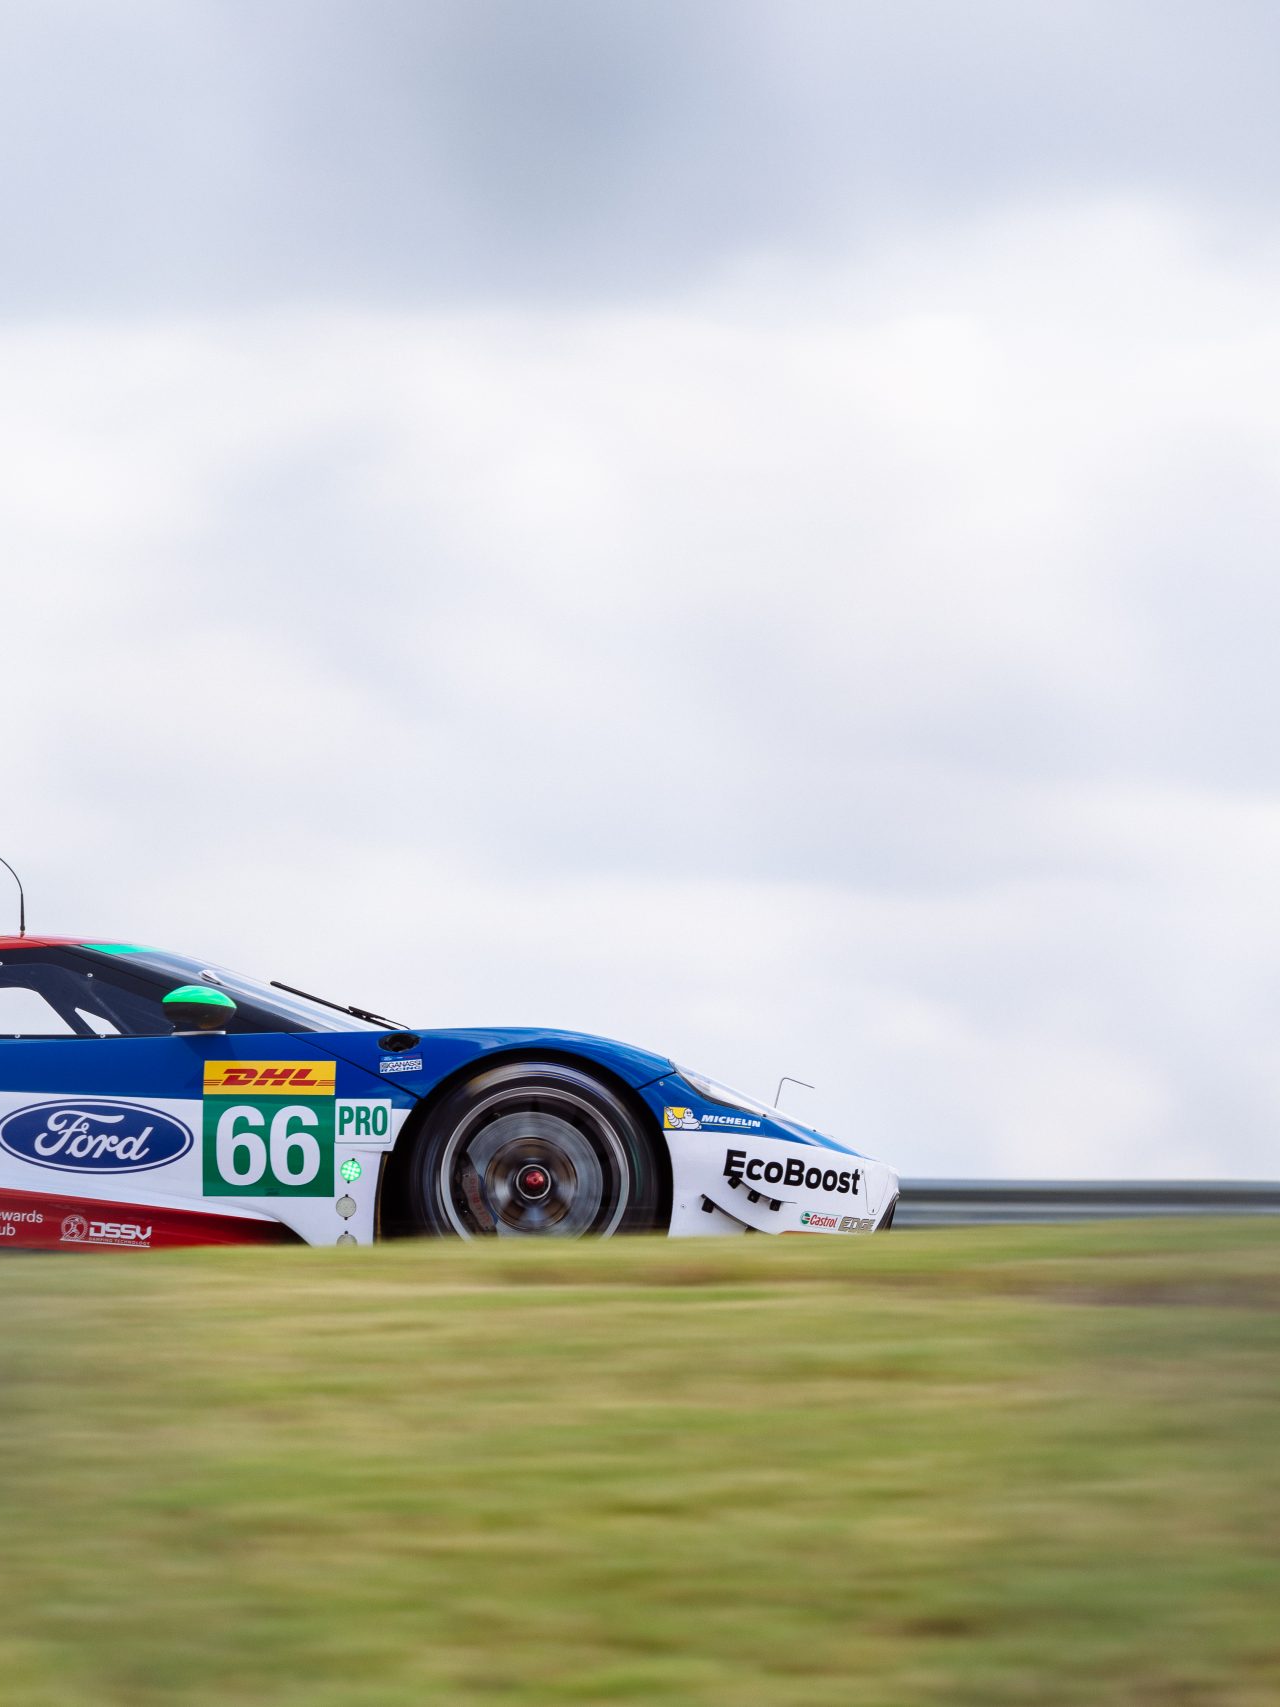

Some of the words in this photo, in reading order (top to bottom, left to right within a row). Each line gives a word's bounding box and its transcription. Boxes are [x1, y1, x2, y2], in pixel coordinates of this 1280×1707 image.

[221, 1068, 318, 1086] DHL
[339, 1106, 388, 1136] PRO
[701, 1115, 761, 1127] MICHELIN
[34, 1110, 154, 1160] Ford
[216, 1105, 320, 1186] 66
[723, 1149, 861, 1195] EcoBoost
[89, 1221, 152, 1240] DSSV
[809, 1214, 838, 1228] Castrol
